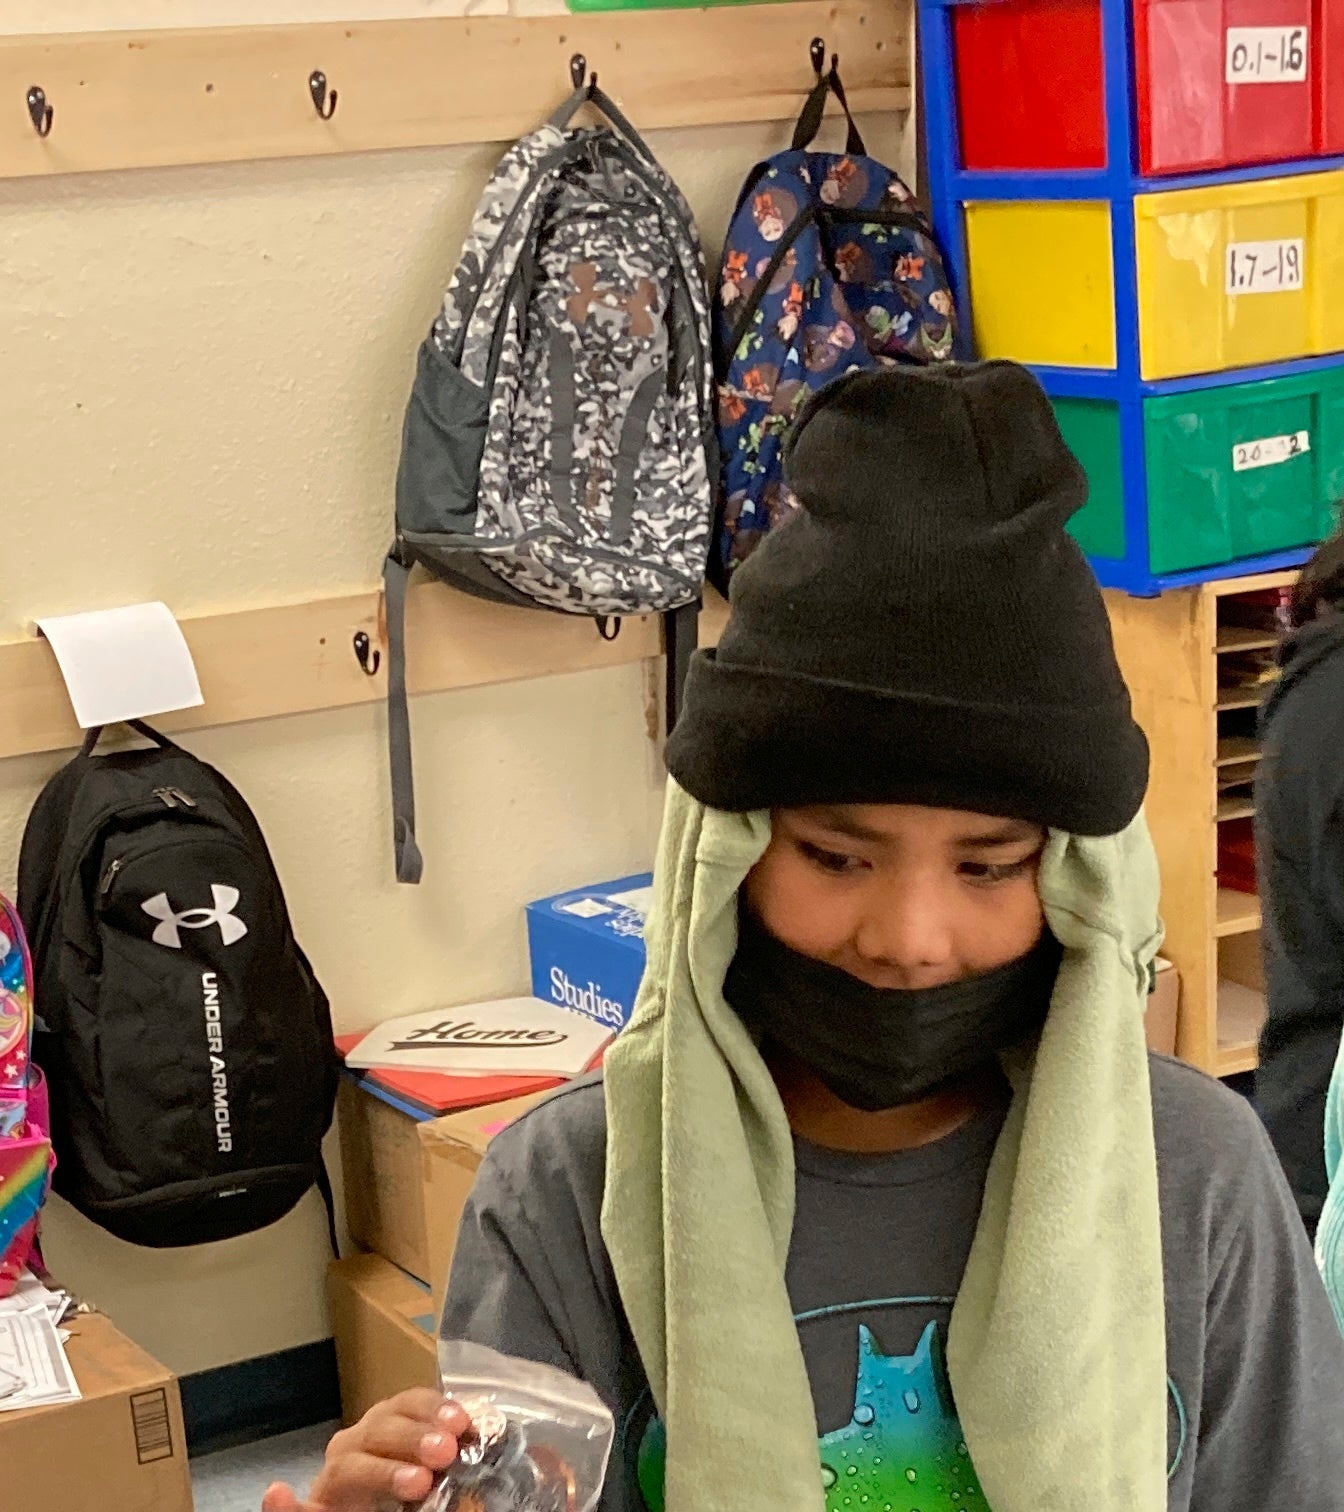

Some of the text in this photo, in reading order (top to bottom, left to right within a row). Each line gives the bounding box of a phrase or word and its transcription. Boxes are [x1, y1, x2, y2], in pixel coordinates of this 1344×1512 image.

[1231, 245, 1300, 287] 1.7-1.9
[550, 966, 624, 1026] Studies
[406, 1021, 568, 1041] Home
[202, 972, 233, 1152] UNDER ARMOUR
